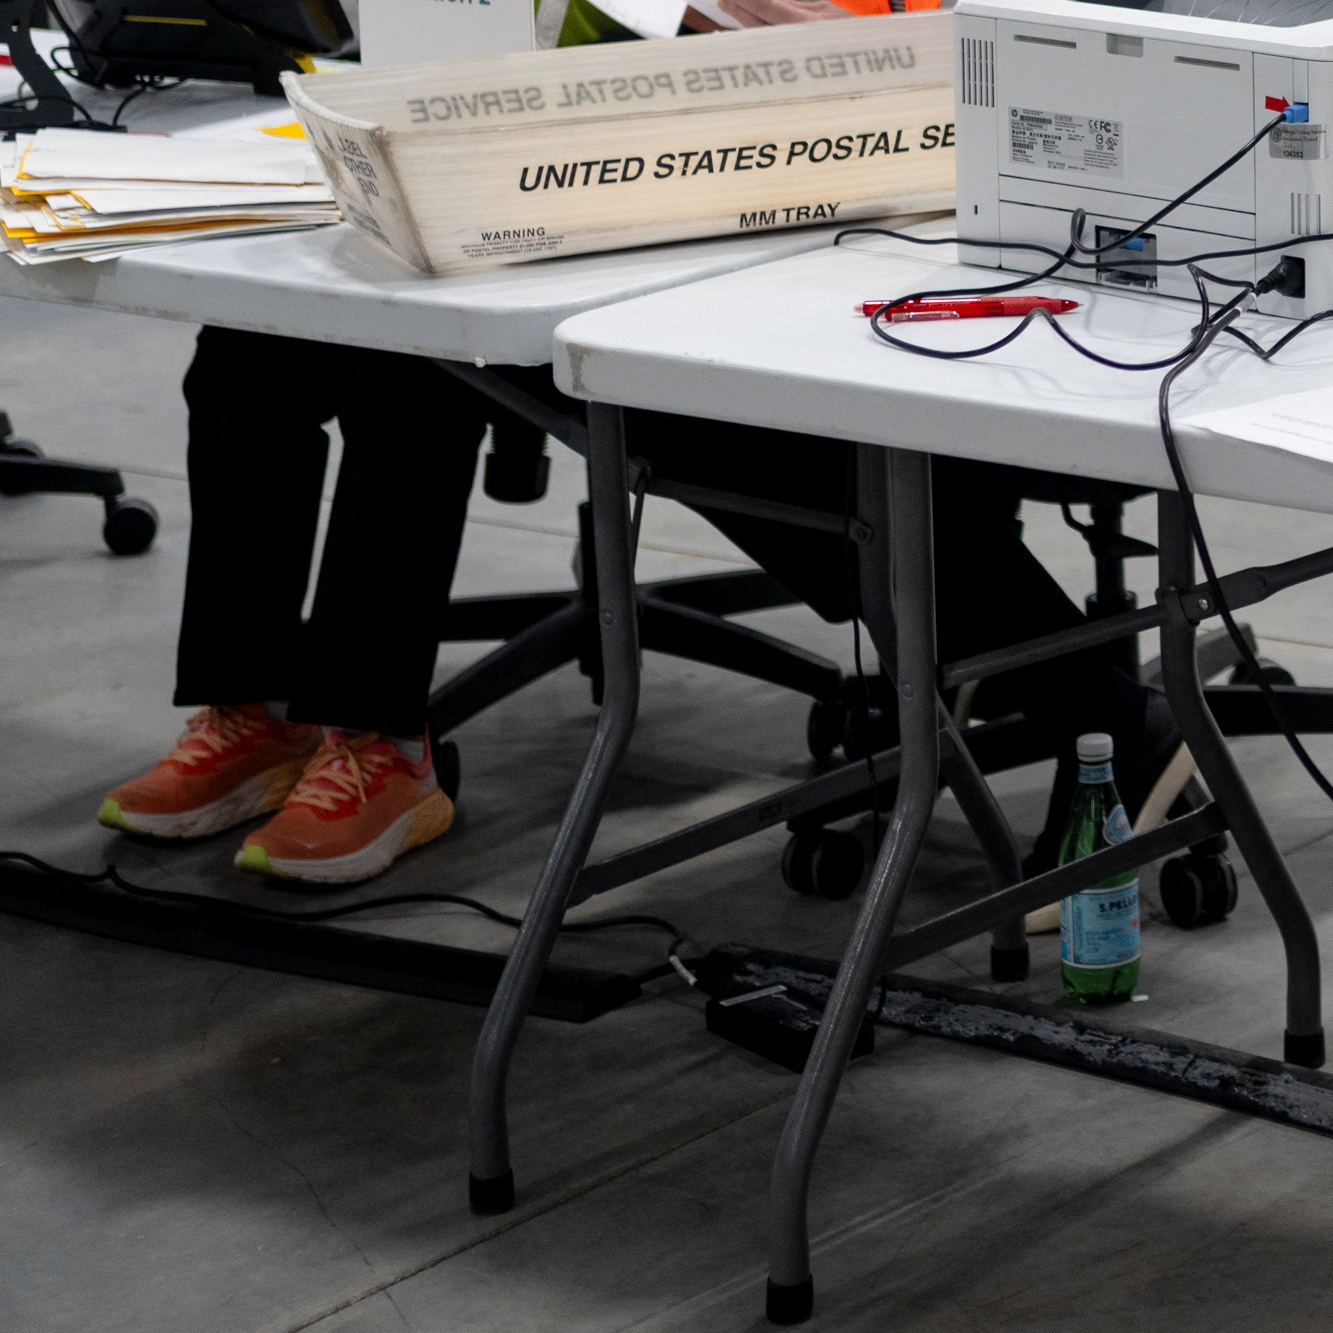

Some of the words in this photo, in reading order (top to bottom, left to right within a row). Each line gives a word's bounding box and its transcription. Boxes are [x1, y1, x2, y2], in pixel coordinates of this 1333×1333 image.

[343, 155, 378, 180] OTHER
[518, 156, 645, 192] UNITED
[653, 143, 779, 179] STATES
[786, 129, 910, 167] POSTAL
[919, 123, 955, 149] SE
[357, 176, 379, 197] END
[739, 209, 777, 229] MM
[782, 201, 841, 223] TRAY
[481, 226, 546, 242] WARNING
